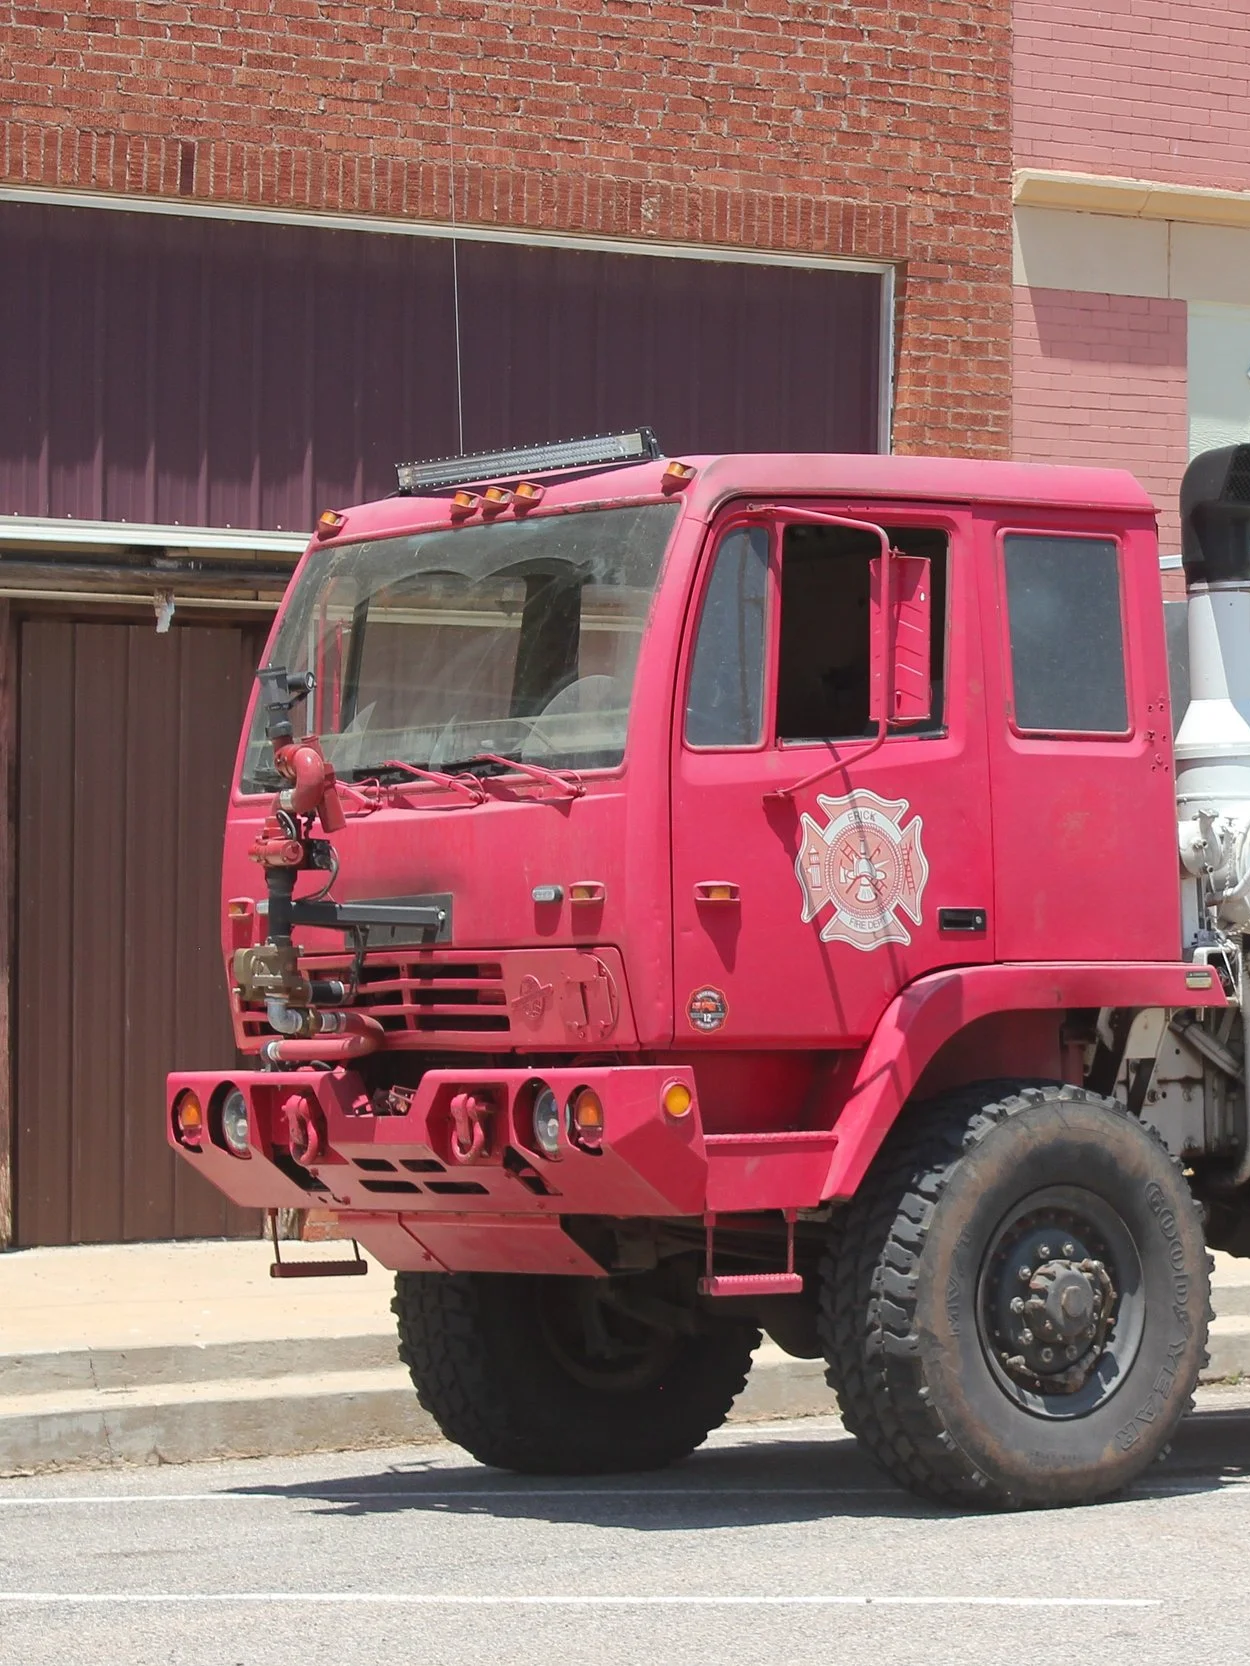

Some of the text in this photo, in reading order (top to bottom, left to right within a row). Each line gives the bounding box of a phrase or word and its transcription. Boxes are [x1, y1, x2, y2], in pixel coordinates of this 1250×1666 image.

[847, 810, 876, 822] ERICK
[849, 917, 867, 930] FIRE
[703, 1013, 712, 1022] 12
